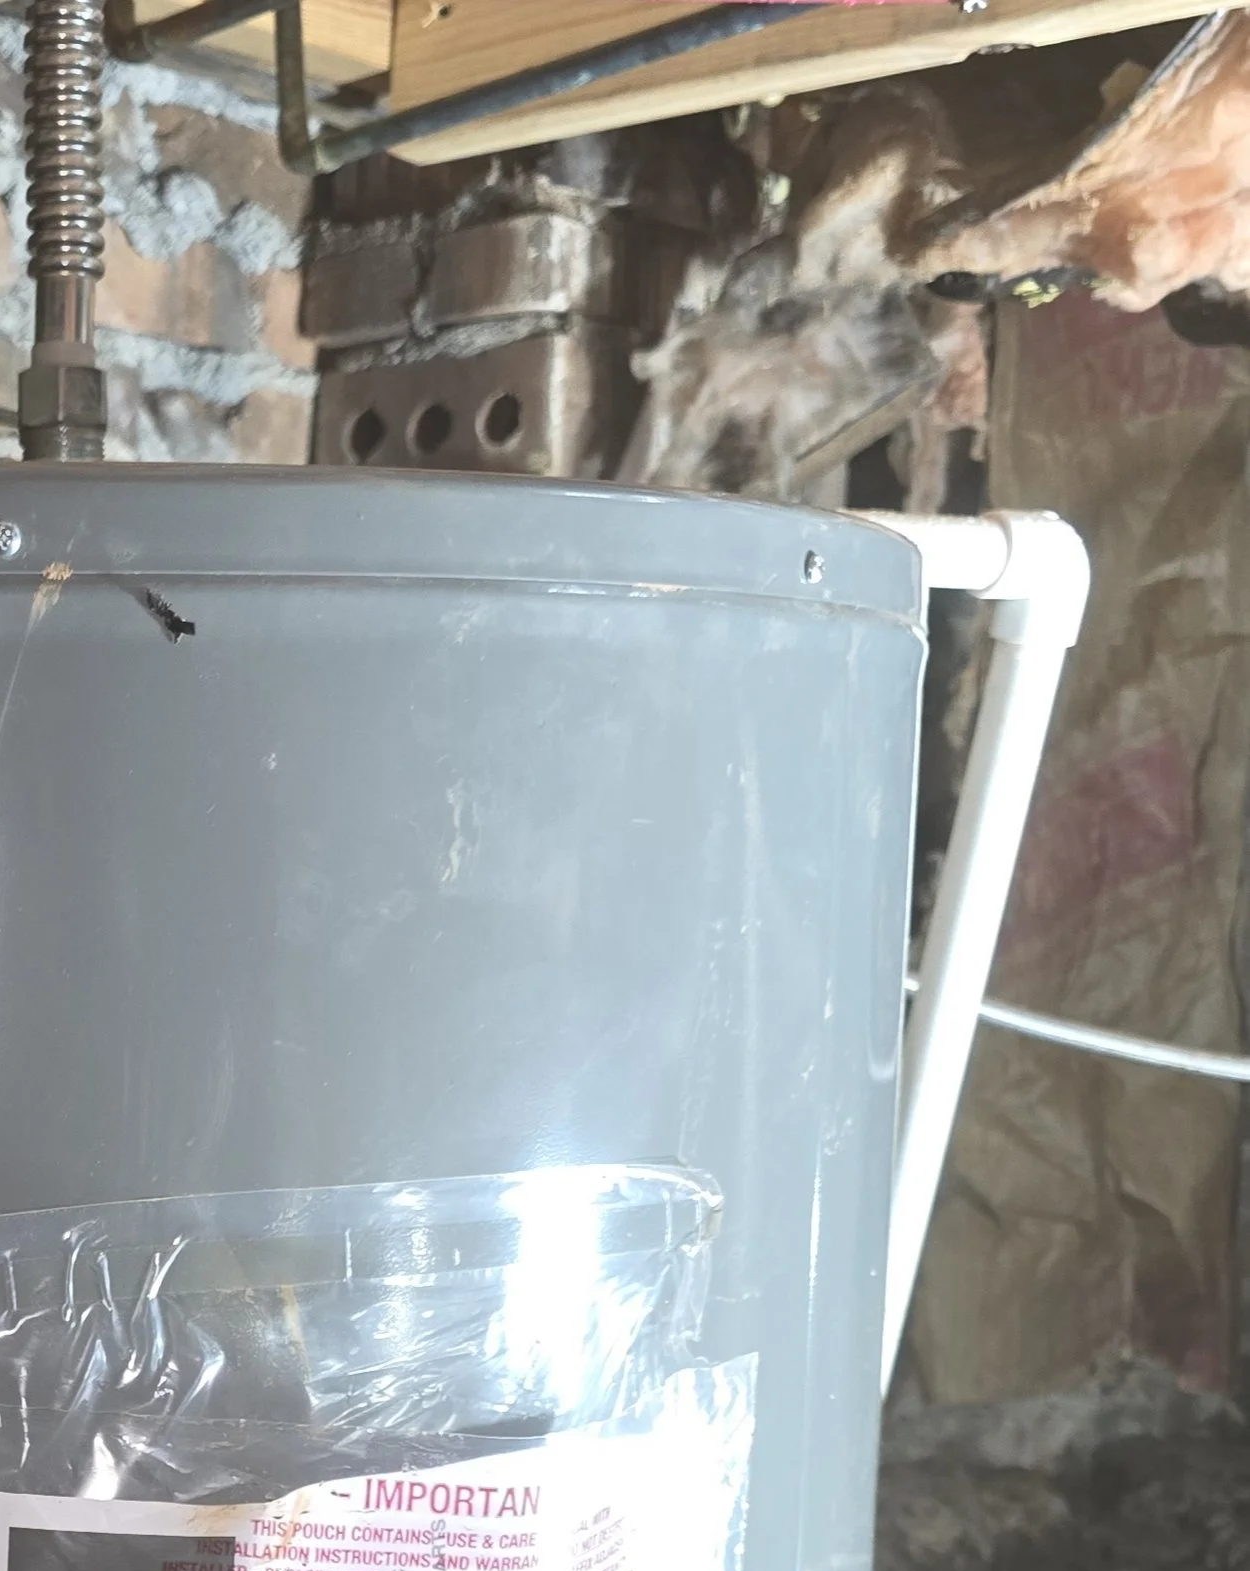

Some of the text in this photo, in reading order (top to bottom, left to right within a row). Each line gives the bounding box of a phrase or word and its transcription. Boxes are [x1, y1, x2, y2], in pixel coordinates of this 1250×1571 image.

[363, 1478, 541, 1518] IMPORTAN
[252, 1520, 287, 1536] THIS
[292, 1523, 346, 1540] POUCH
[351, 1526, 432, 1546] CONTAINS
[482, 1533, 500, 1549] &
